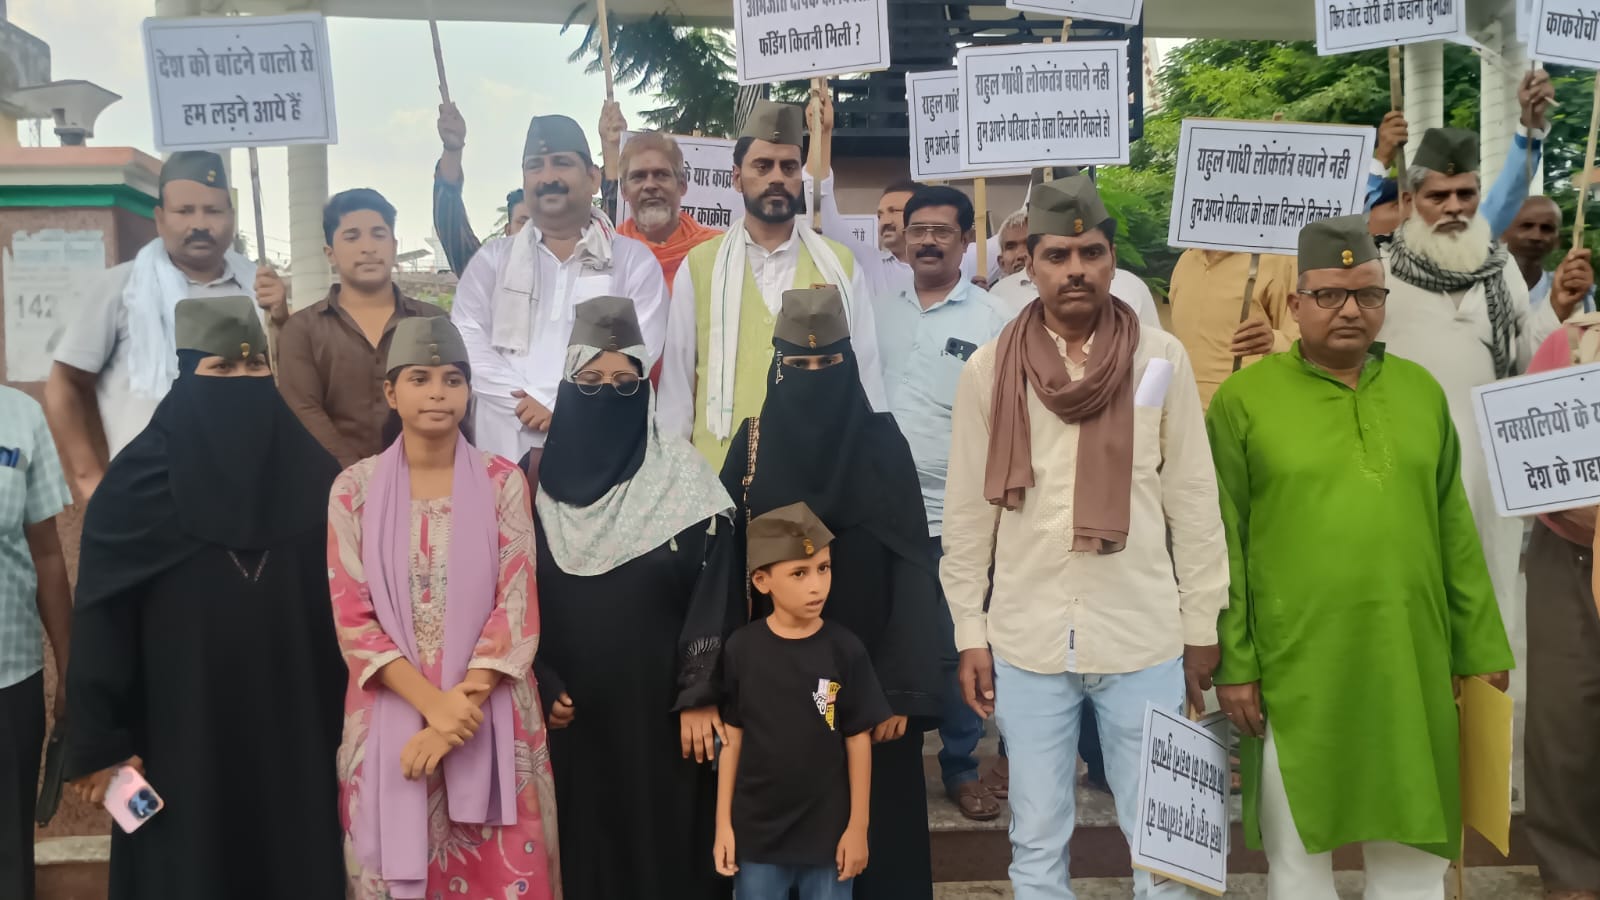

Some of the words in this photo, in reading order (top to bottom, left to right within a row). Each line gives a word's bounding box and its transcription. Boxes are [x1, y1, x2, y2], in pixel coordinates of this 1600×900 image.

[1329, 5, 1344, 31] फिर
[1346, 2, 1361, 28] वोट
[1363, 0, 1380, 25] चोरी
[788, 25, 822, 53] कितनी
[825, 21, 851, 49] मिली
[855, 23, 861, 46] ?
[156, 50, 185, 78] देश
[187, 48, 210, 77] को
[214, 46, 255, 76] बांटने
[258, 44, 297, 74] वालो
[299, 43, 314, 72] से
[975, 72, 1000, 104] राहुल
[1001, 65, 1024, 94] गांधी
[1025, 64, 1063, 93] लोकतंत्र
[1064, 62, 1091, 92] बचाने
[1092, 61, 1110, 91] नही
[182, 103, 206, 126] हम
[210, 95, 249, 131] लड़ने
[253, 93, 286, 124] आये
[286, 92, 302, 121] हैं
[921, 95, 943, 122] राहुल
[924, 137, 934, 164] तुम
[935, 130, 950, 155] अपने
[976, 121, 988, 151] तुम
[988, 114, 1006, 143] अपने
[1007, 112, 1030, 142] परिवार
[1030, 111, 1041, 140] को
[1056, 110, 1079, 139] दिलाने
[1080, 109, 1101, 138] निकले
[1102, 109, 1110, 138] हो
[693, 168, 711, 186] यार
[1197, 148, 1225, 181] राहुल
[1226, 143, 1252, 175] गांधी
[1253, 144, 1296, 176] लोकतंत्र
[1297, 147, 1328, 179] बचाने
[1329, 148, 1351, 180] नही
[697, 203, 732, 227] काक्रोच
[1189, 198, 1204, 230] तुम
[1204, 193, 1225, 222] अपने
[1225, 194, 1250, 224] परिवार
[1250, 195, 1262, 225] को
[1280, 197, 1305, 227] दिलाने
[1494, 401, 1570, 443] नक्सलियों
[1571, 398, 1589, 429] के
[1523, 461, 1552, 491] देश
[1553, 455, 1571, 486] के
[1151, 732, 1172, 773] सुनाओ
[1172, 745, 1190, 782] कहानी
[1191, 753, 1199, 790] की
[1146, 797, 1155, 837] दो
[1157, 801, 1183, 842] इस्तीफा
[1183, 803, 1195, 842] तुम
[1195, 808, 1209, 848] राहुल
